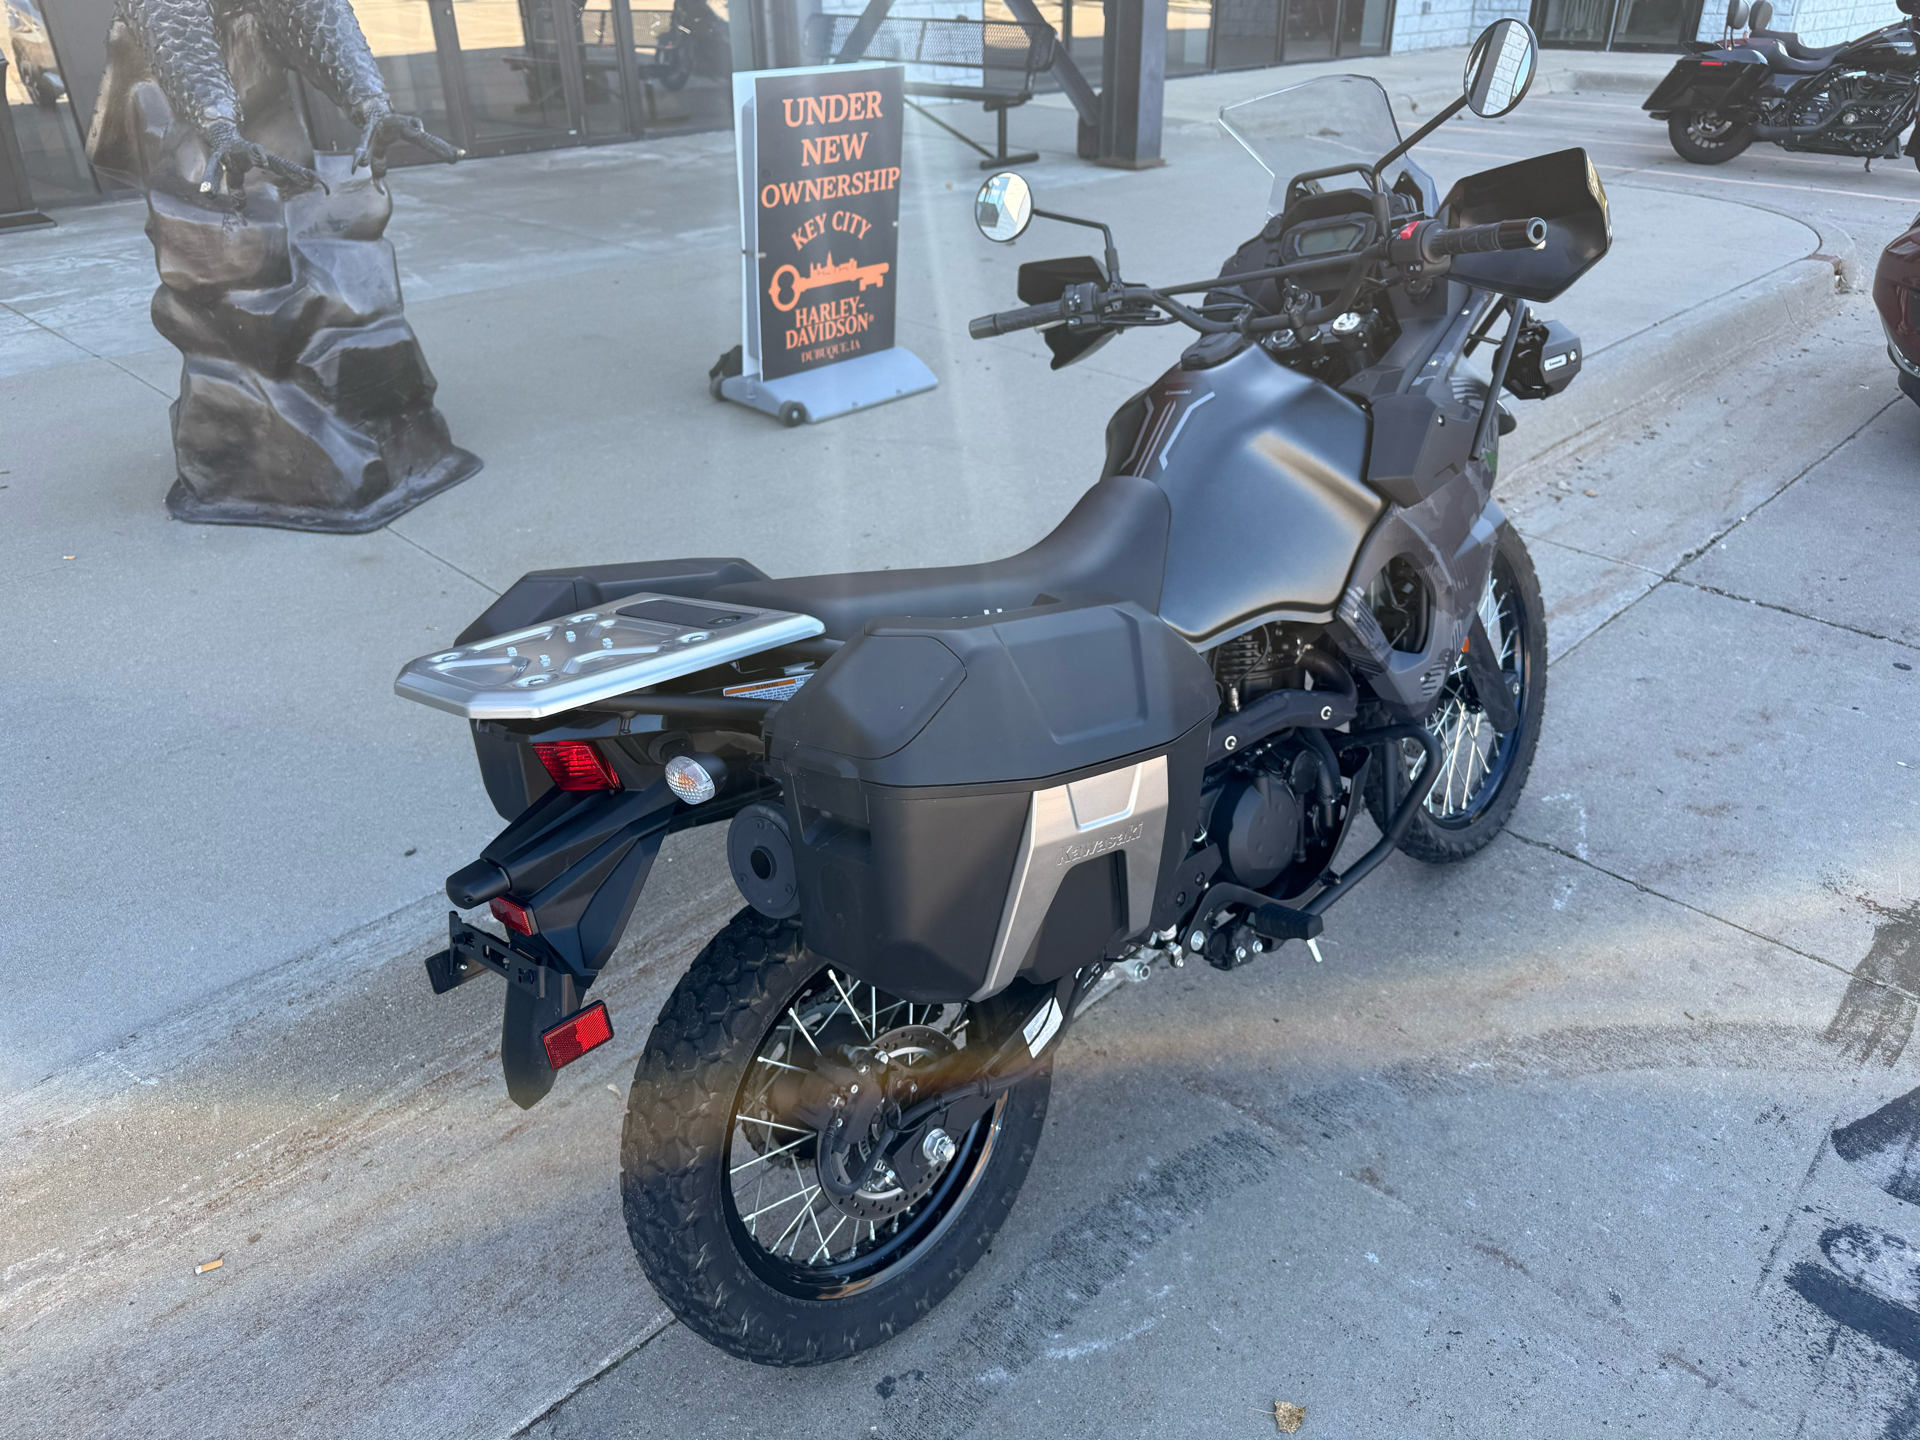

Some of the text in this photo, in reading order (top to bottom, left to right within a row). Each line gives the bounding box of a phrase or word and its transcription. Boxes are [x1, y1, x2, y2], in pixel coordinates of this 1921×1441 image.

[782, 91, 883, 127] UNDER
[801, 132, 869, 166] NEW
[761, 167, 901, 208] OWNERSHIP
[791, 210, 872, 249] KEY CITY
[795, 297, 865, 328] HARLEY-
[1056, 822, 1144, 866] Kawasaki
